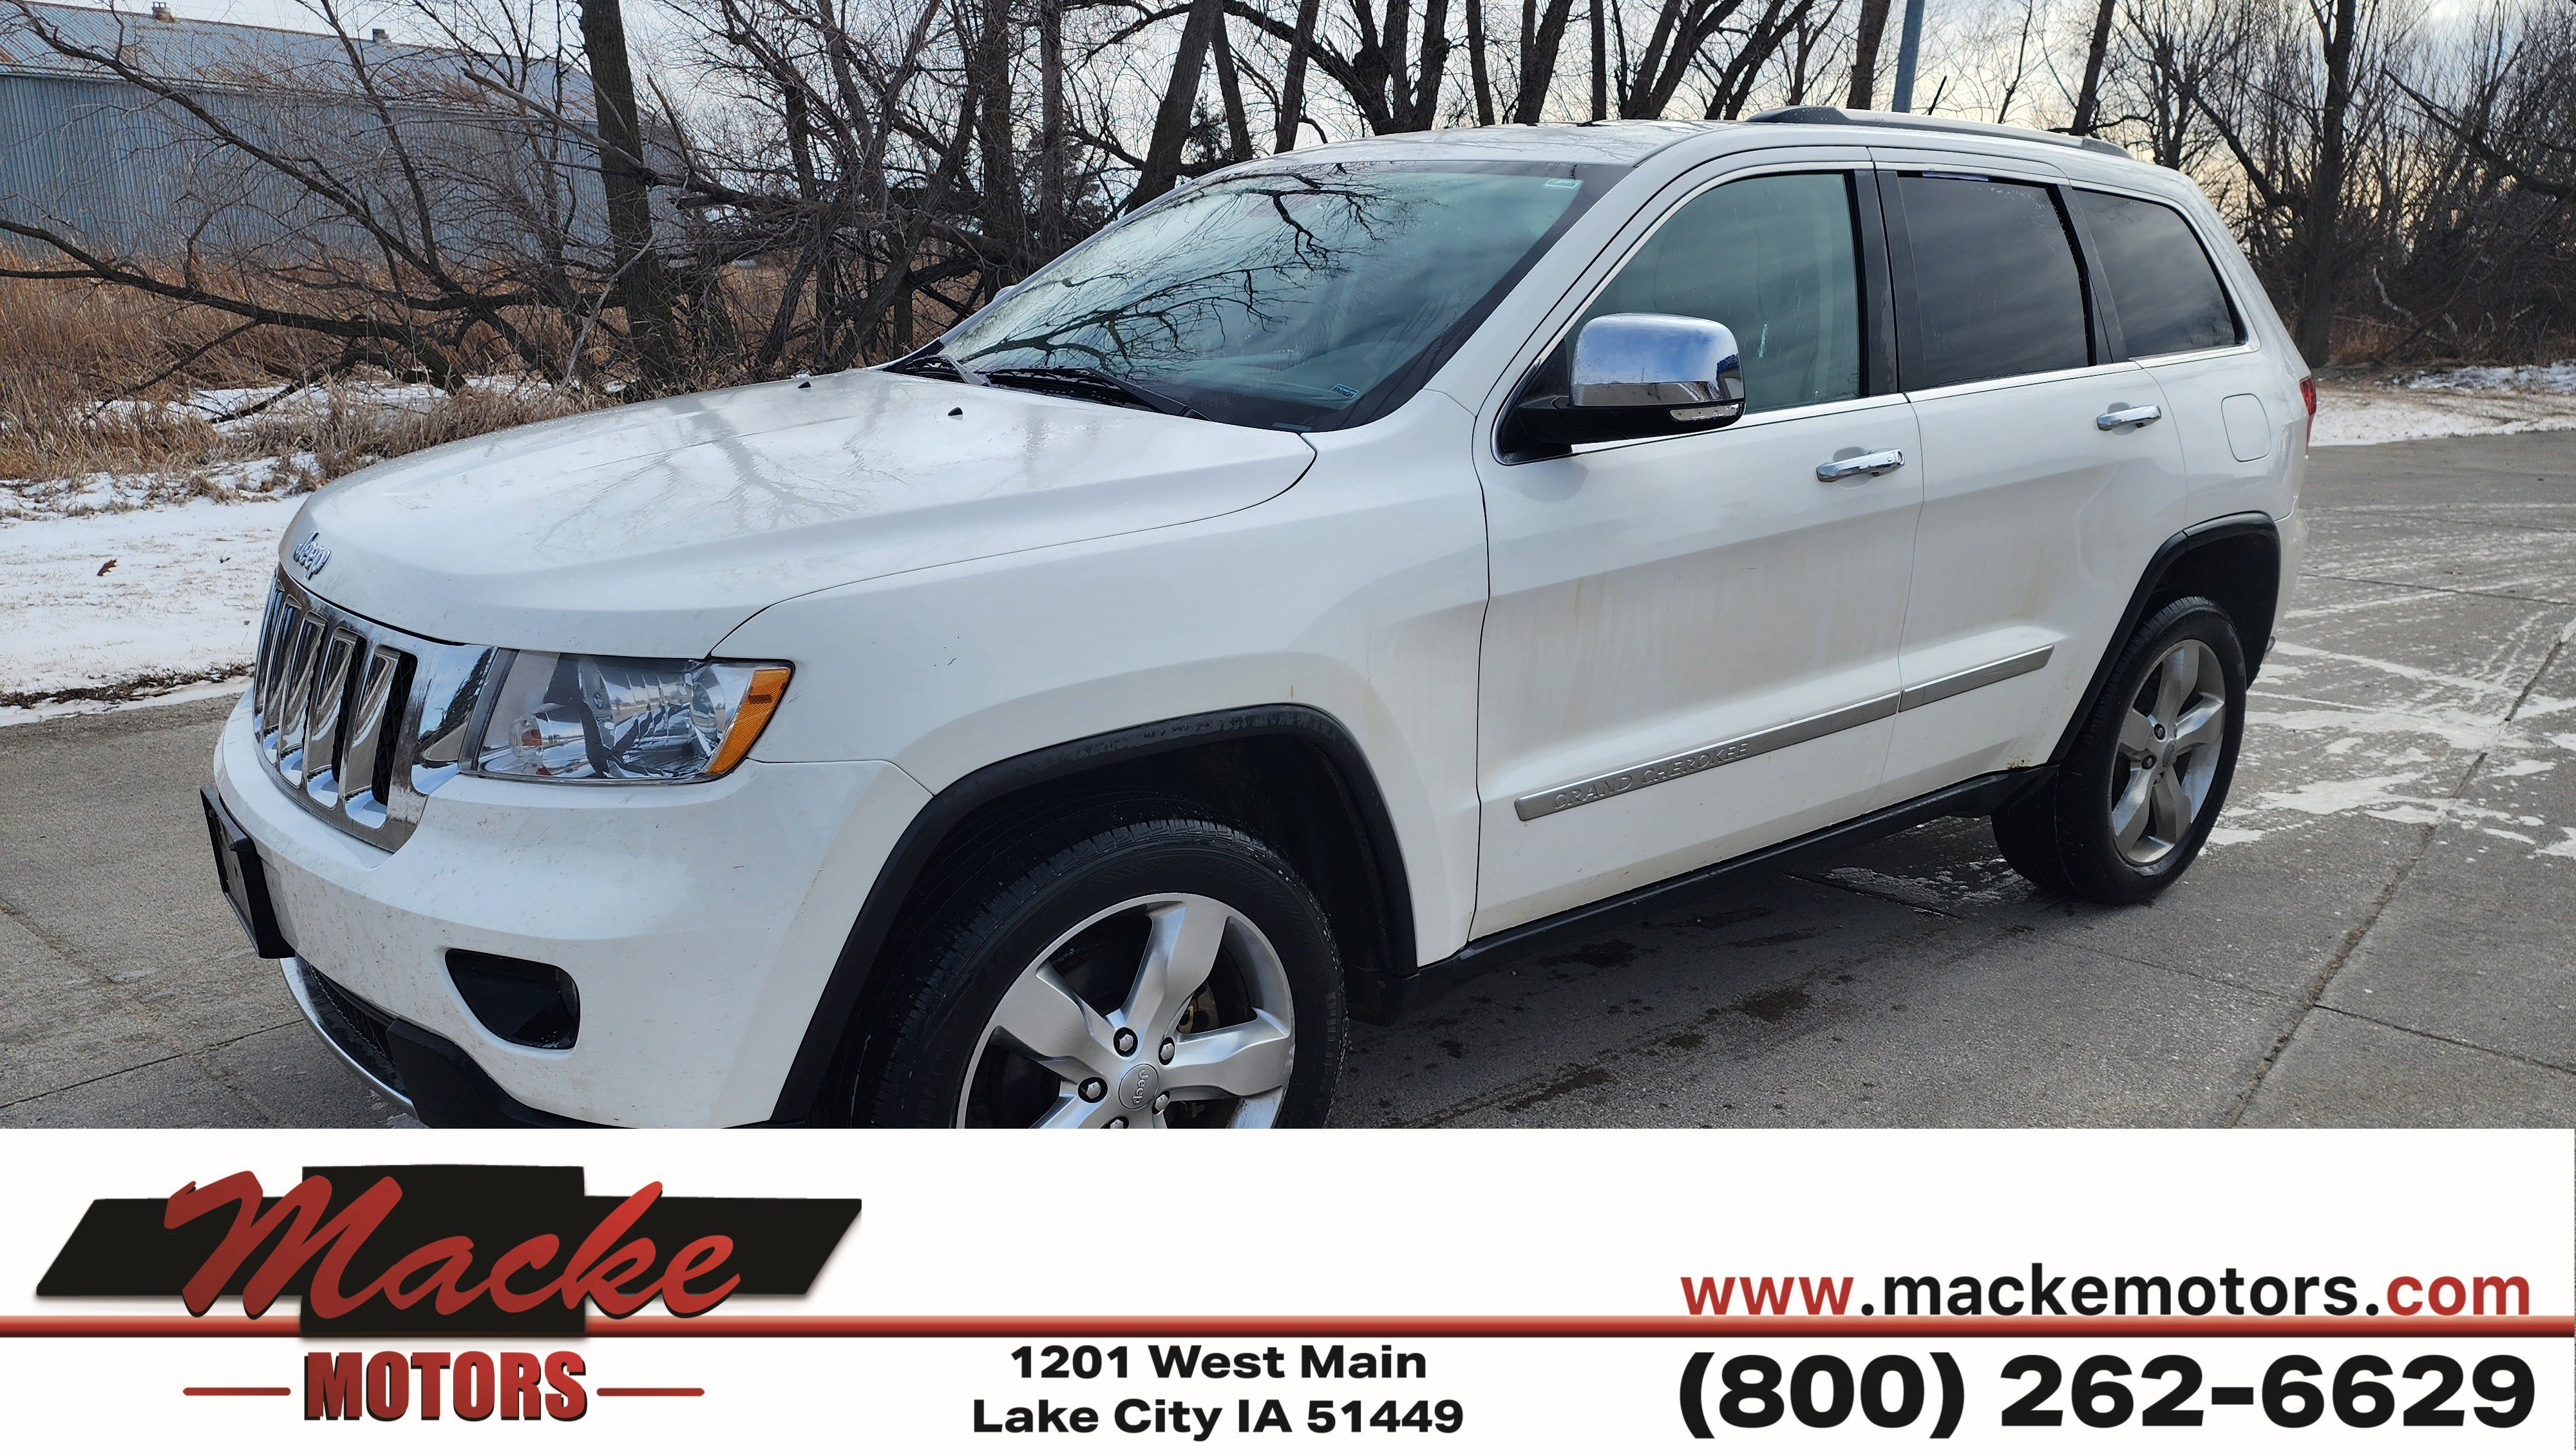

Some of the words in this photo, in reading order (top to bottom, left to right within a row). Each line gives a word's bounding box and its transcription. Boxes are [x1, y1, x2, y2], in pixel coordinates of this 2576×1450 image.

[294, 531, 331, 581] Jeep
[1553, 775, 1633, 809] GRAND
[1642, 742, 1749, 785] CHEROKEE
[1132, 1069, 1150, 1105] Jeep
